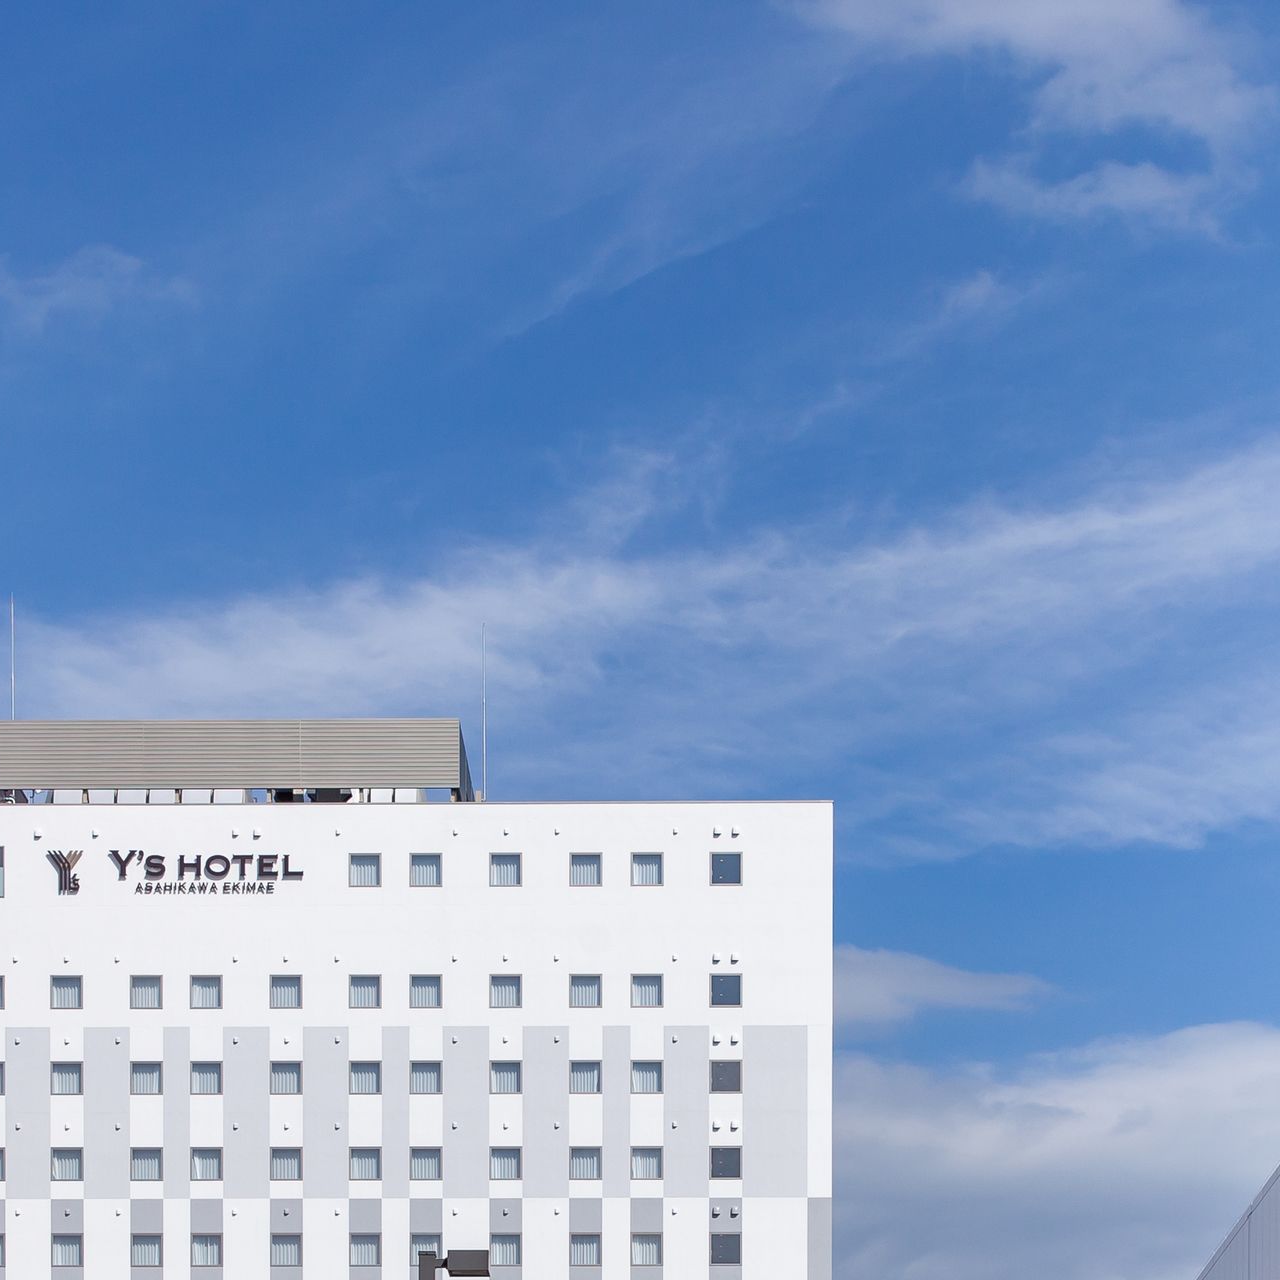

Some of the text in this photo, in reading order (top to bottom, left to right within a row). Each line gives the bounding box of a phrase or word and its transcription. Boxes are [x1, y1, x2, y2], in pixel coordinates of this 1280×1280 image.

[178, 854, 304, 879] HOTEL
[135, 882, 276, 894] ASAHIKAWA EKIMAE
